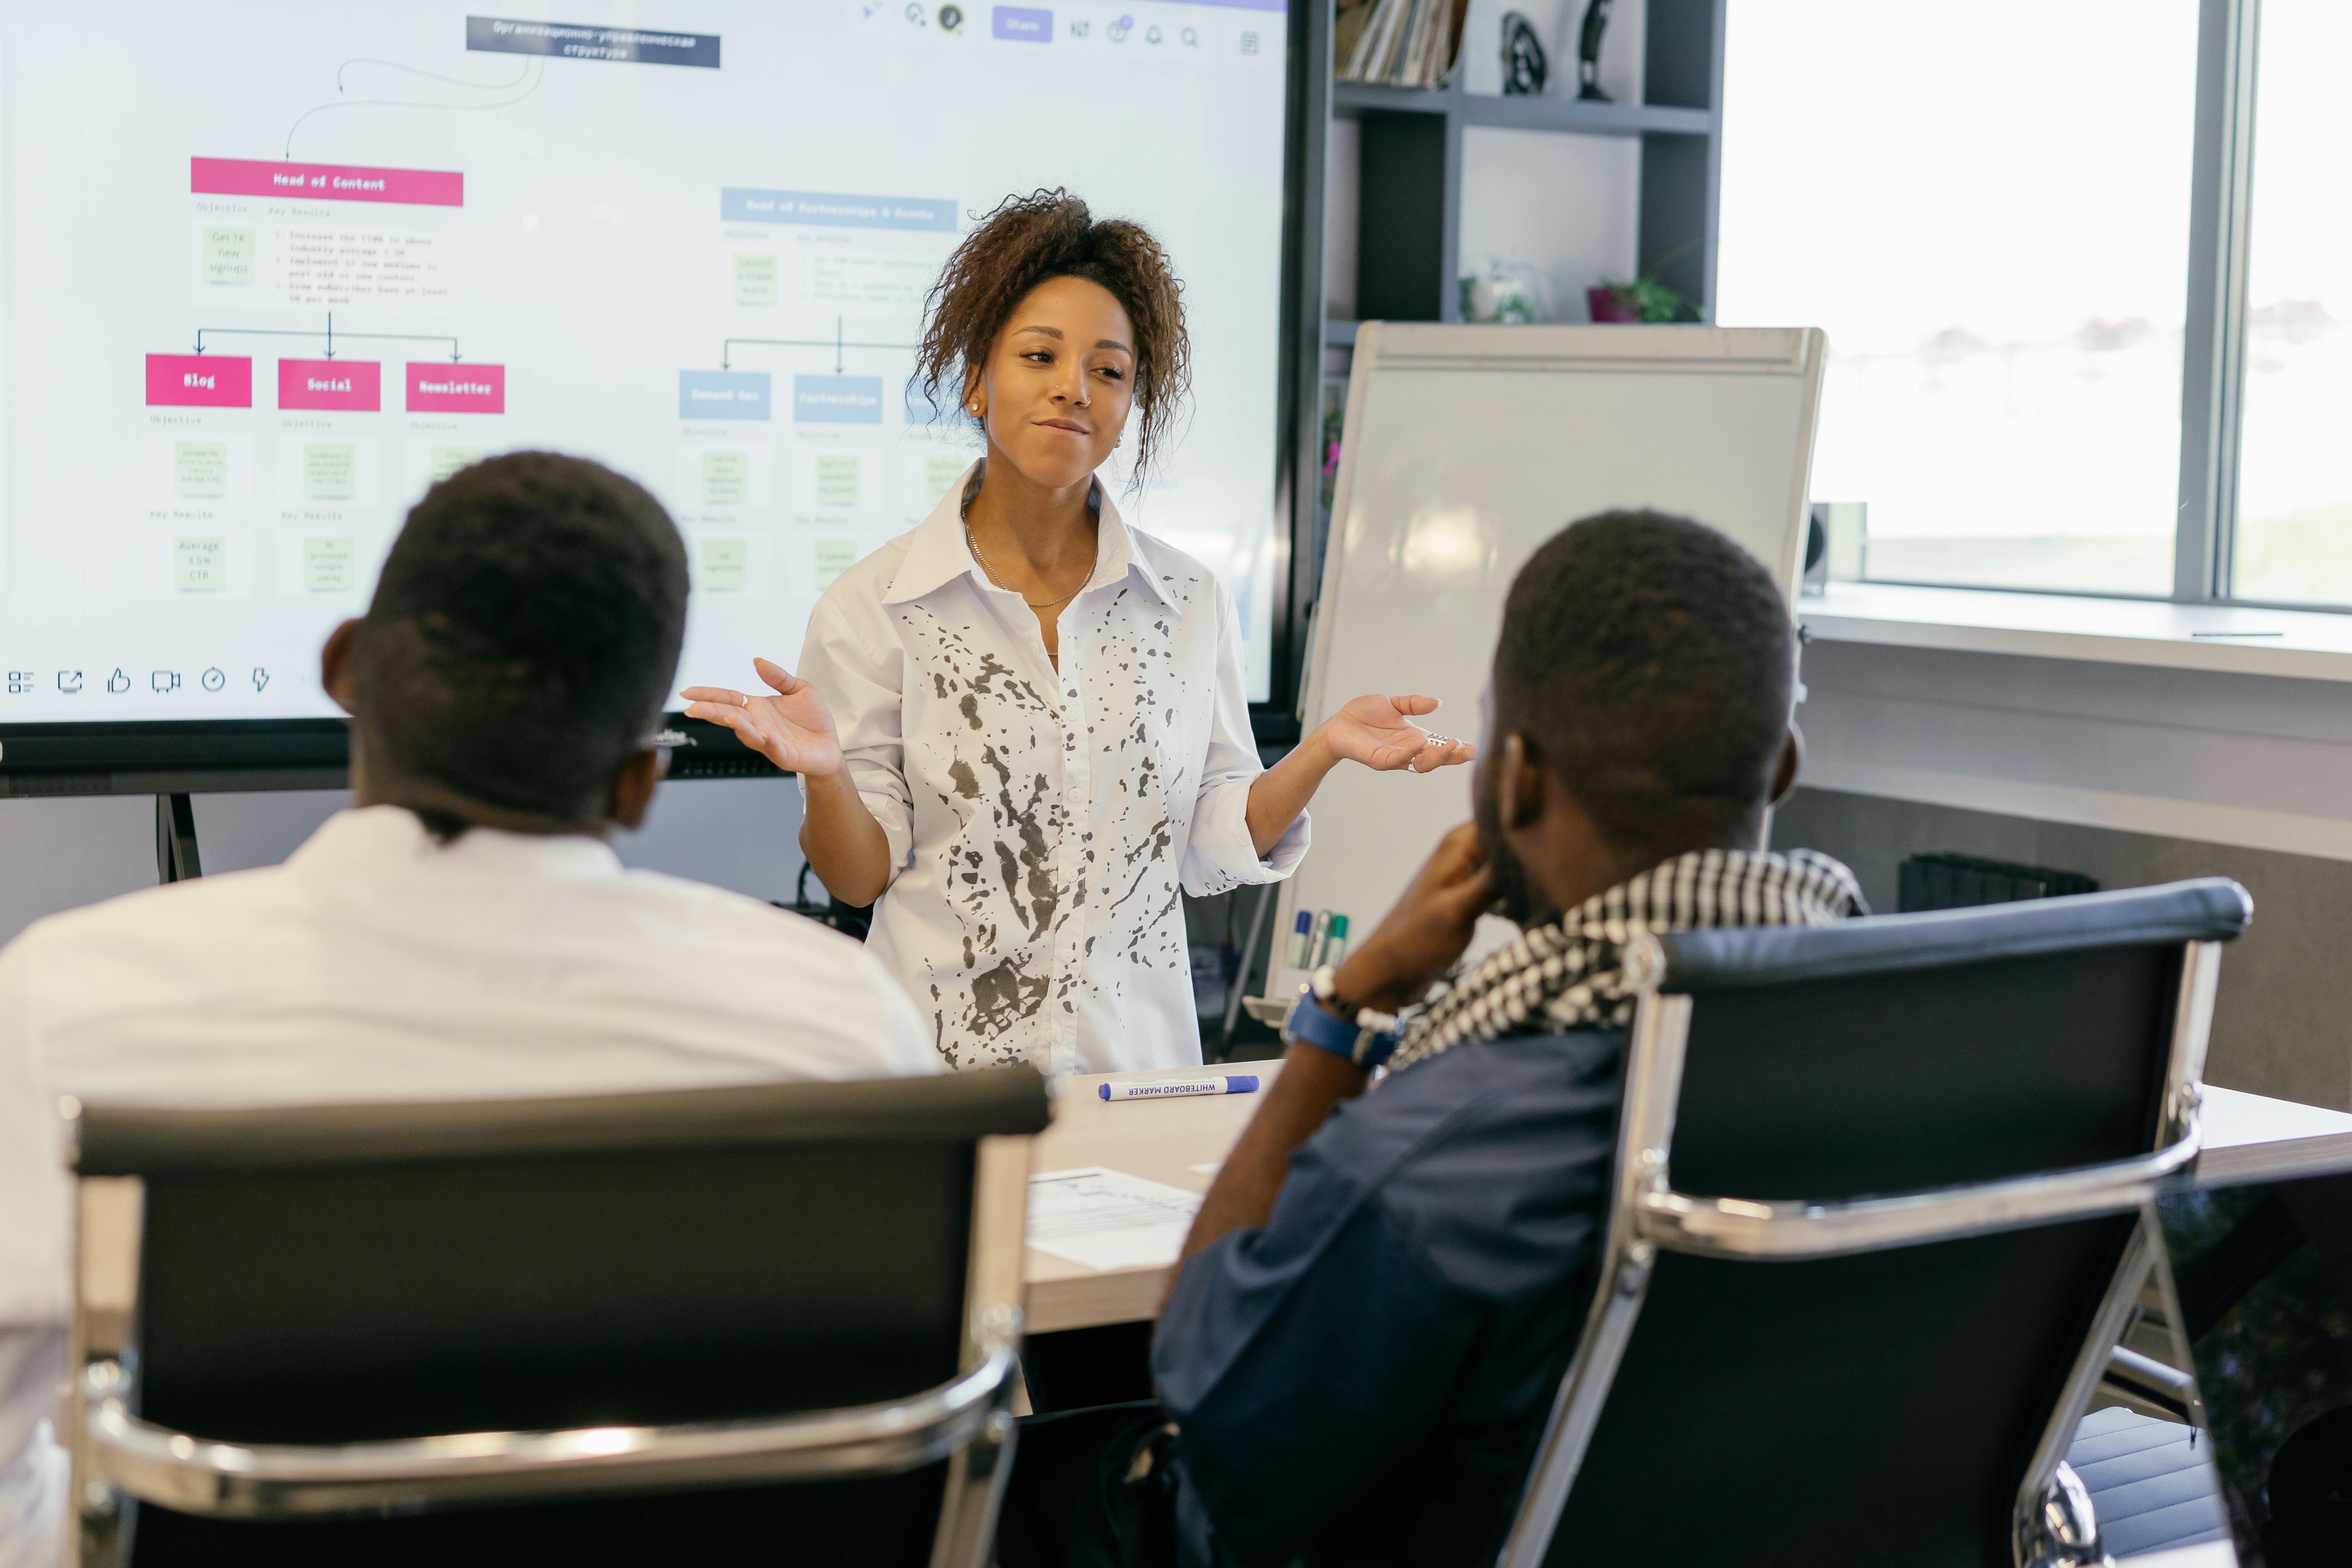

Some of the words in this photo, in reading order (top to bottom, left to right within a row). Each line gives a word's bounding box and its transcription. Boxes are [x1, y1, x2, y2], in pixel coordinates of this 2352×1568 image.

[1006, 18, 1039, 31] Share
[273, 173, 304, 187] Head
[312, 175, 327, 188] of
[333, 176, 385, 191] Content
[197, 201, 247, 214] Objective
[269, 206, 285, 217] Key
[292, 206, 330, 218] Results
[746, 200, 774, 211] Head
[779, 201, 793, 212] of
[799, 203, 877, 218] Partnerships
[894, 208, 934, 220] Events
[212, 232, 230, 244] Get
[234, 232, 245, 244] 1K
[218, 249, 240, 258] new
[209, 263, 249, 276] signups
[183, 373, 215, 390] Blog
[307, 377, 352, 392] Social
[419, 380, 492, 396] Newsletter
[691, 388, 734, 401] Demand
[799, 392, 877, 408] Partnerships
[149, 414, 201, 426] Objective
[281, 417, 332, 430] Objective
[408, 419, 458, 431] Objective
[150, 510, 167, 520] Key
[173, 510, 213, 519] Results
[281, 511, 298, 521] Key
[304, 510, 343, 521] Results
[179, 540, 220, 553] Average
[189, 569, 209, 582] CTR
[1129, 1087, 1161, 1096] MARKER
[1164, 1083, 1216, 1094] WHITEBOARD
